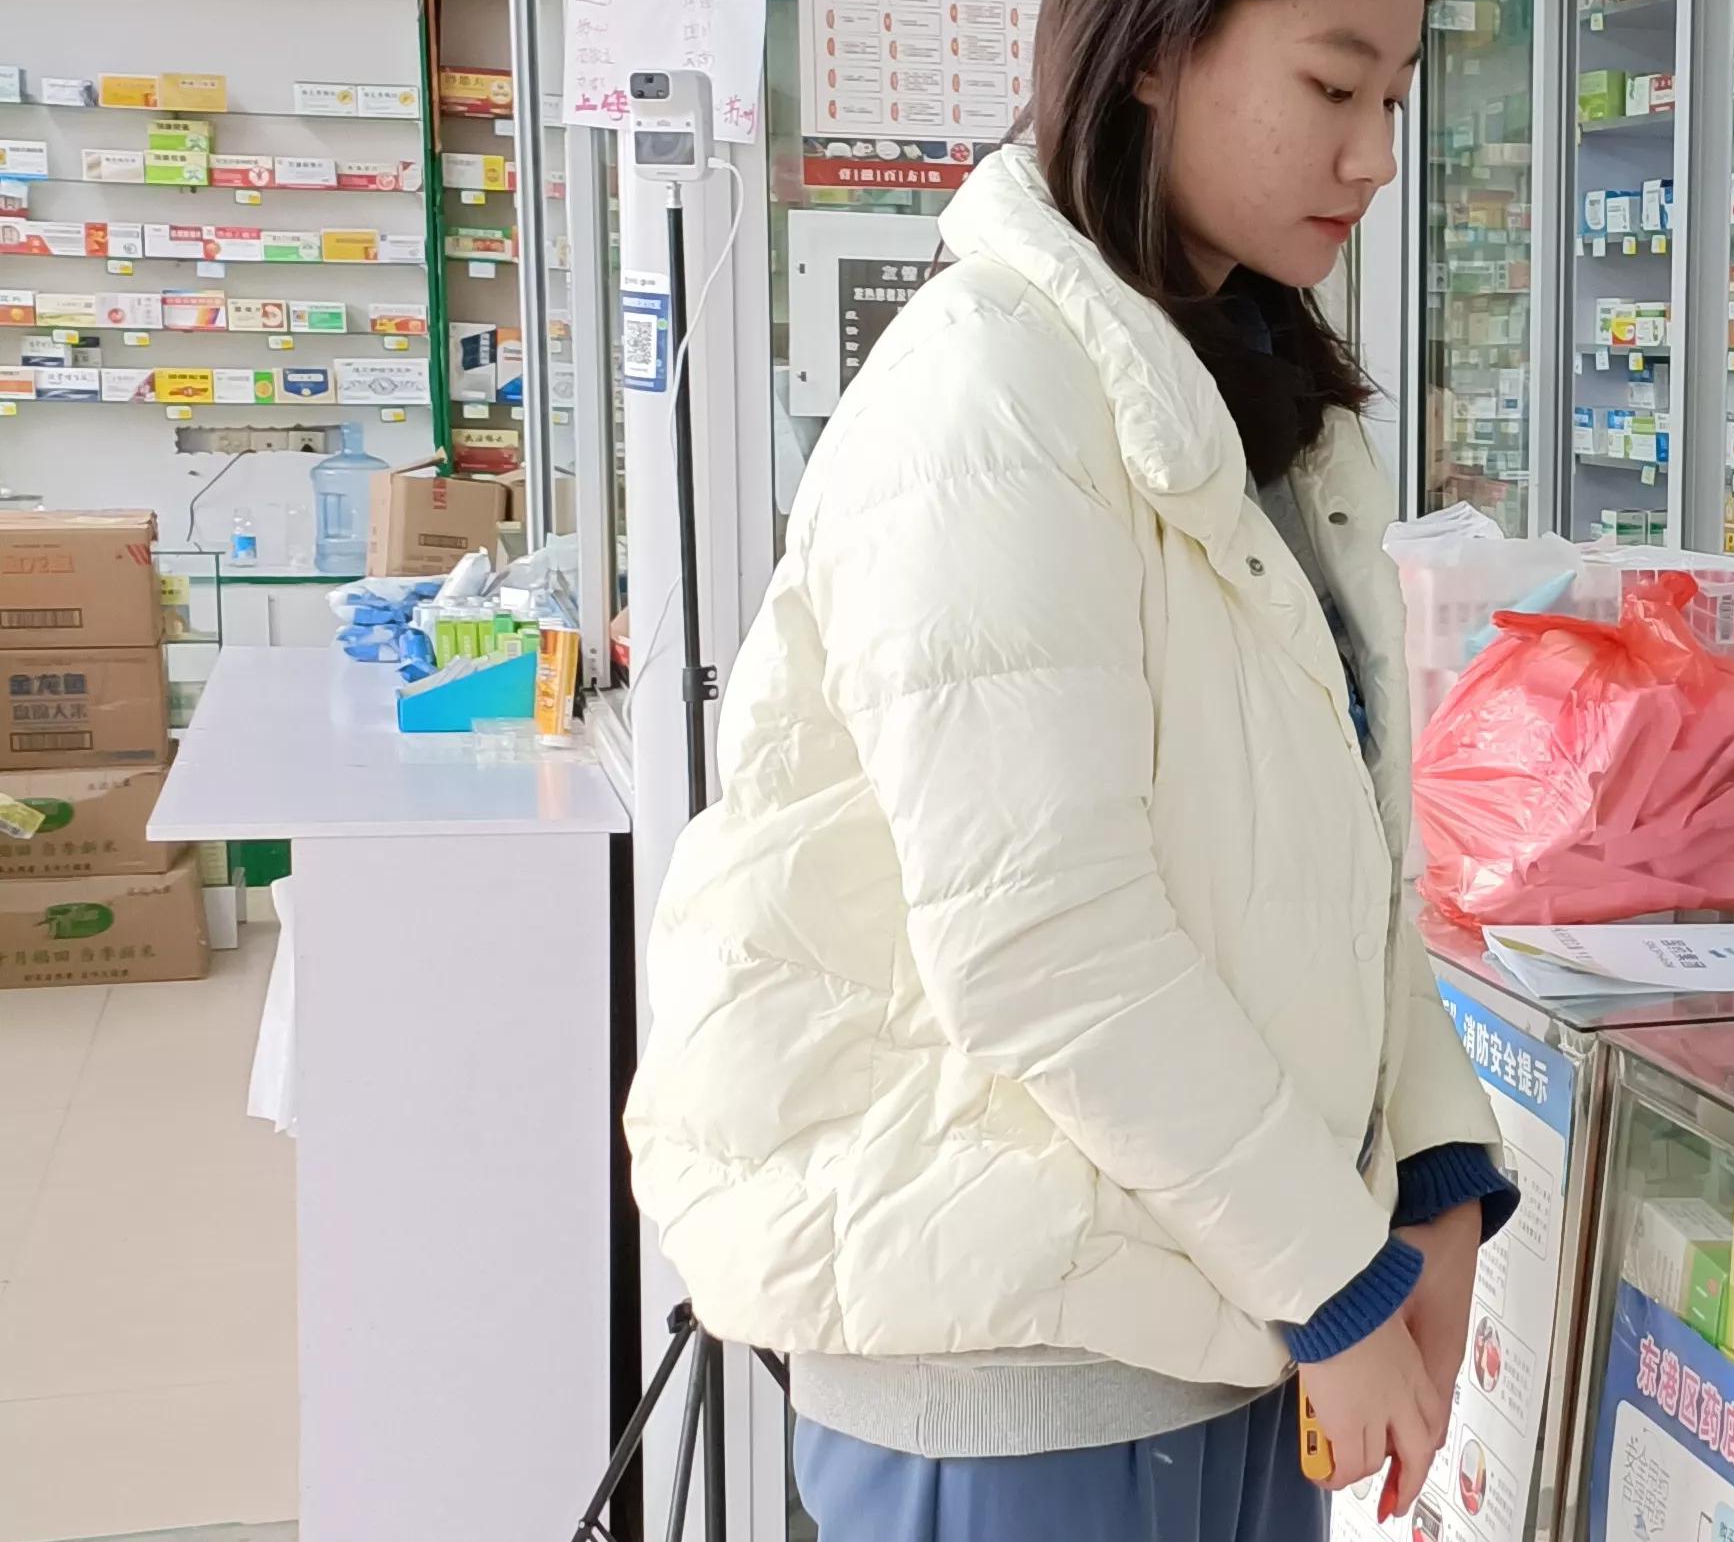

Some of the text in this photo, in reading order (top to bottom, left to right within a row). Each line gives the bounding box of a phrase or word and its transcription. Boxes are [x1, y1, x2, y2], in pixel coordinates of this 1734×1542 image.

[1462, 1011, 1550, 1105] 消防安全提示
